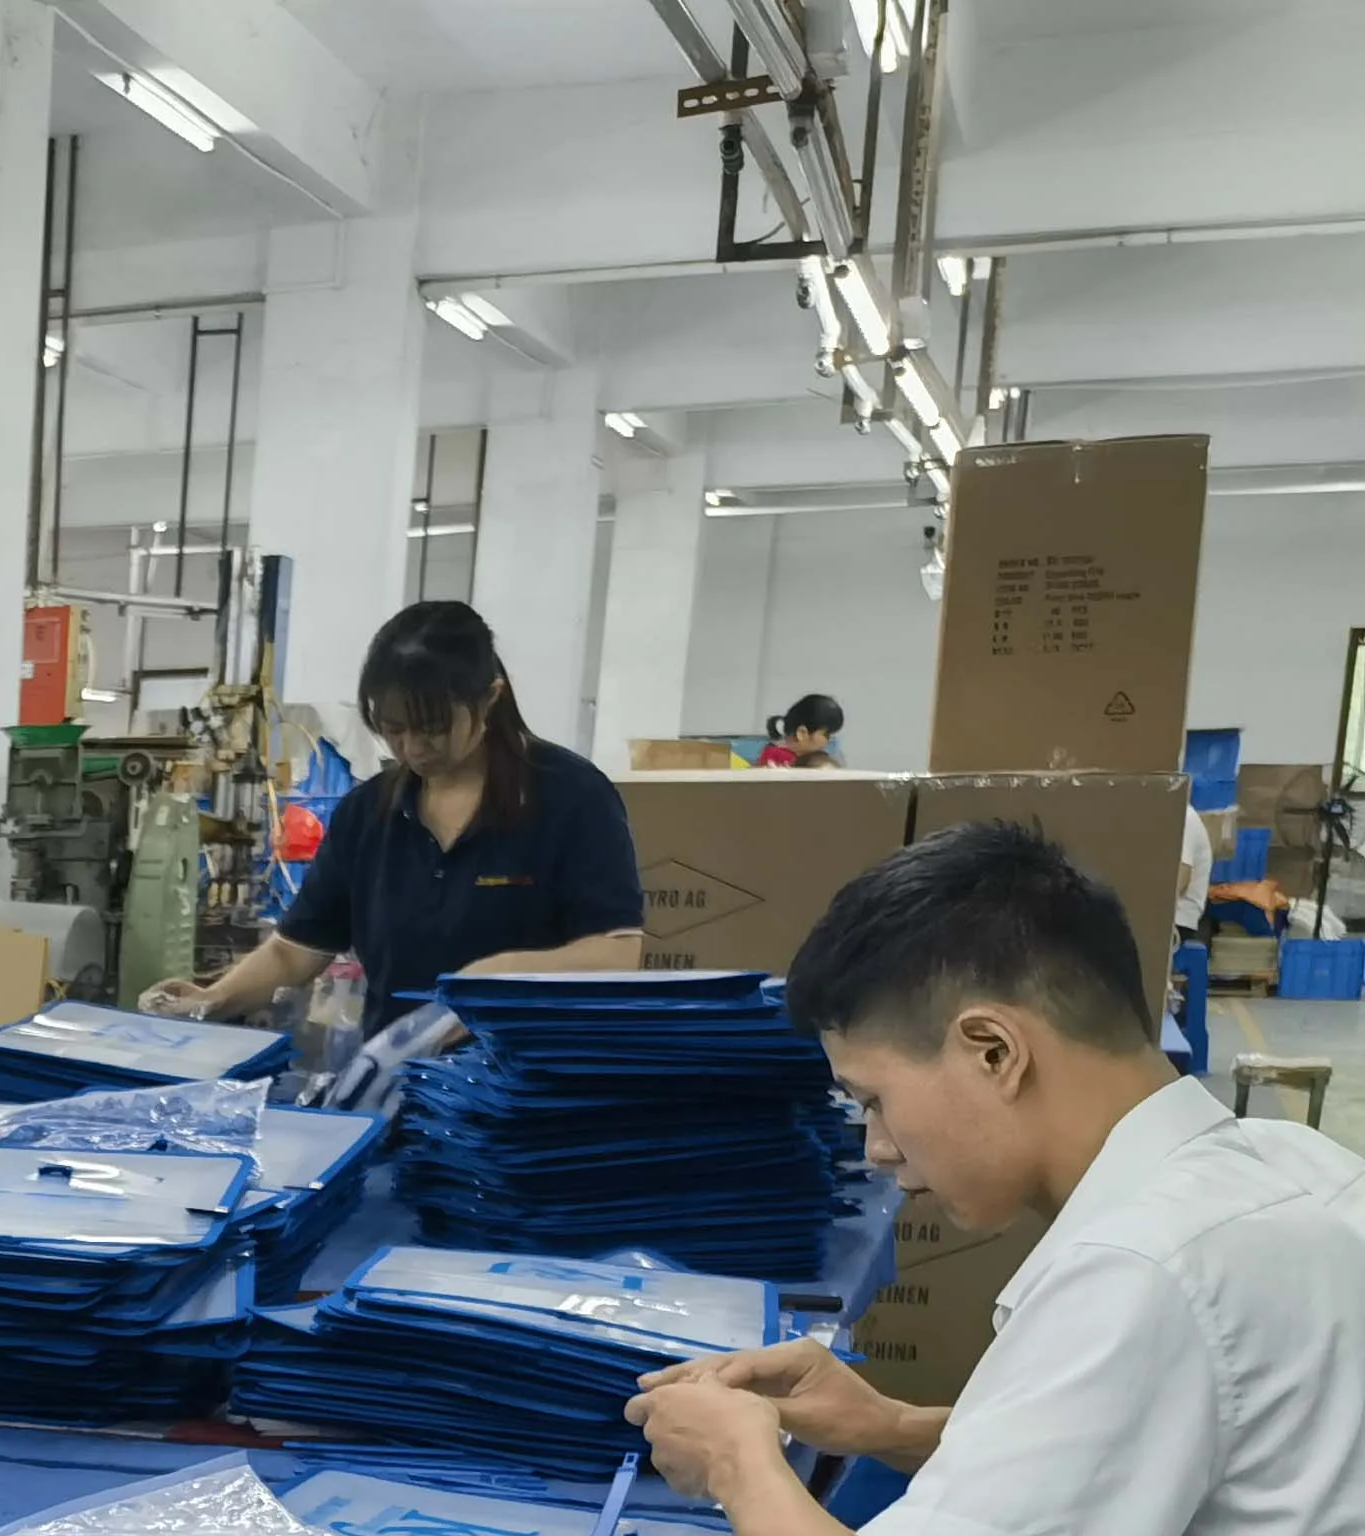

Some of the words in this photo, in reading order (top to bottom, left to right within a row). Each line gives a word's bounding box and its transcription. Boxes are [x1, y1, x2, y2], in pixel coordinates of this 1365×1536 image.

[684, 889, 707, 908] AG
[643, 952, 696, 970] EINEN
[877, 1285, 930, 1306] EINEN
